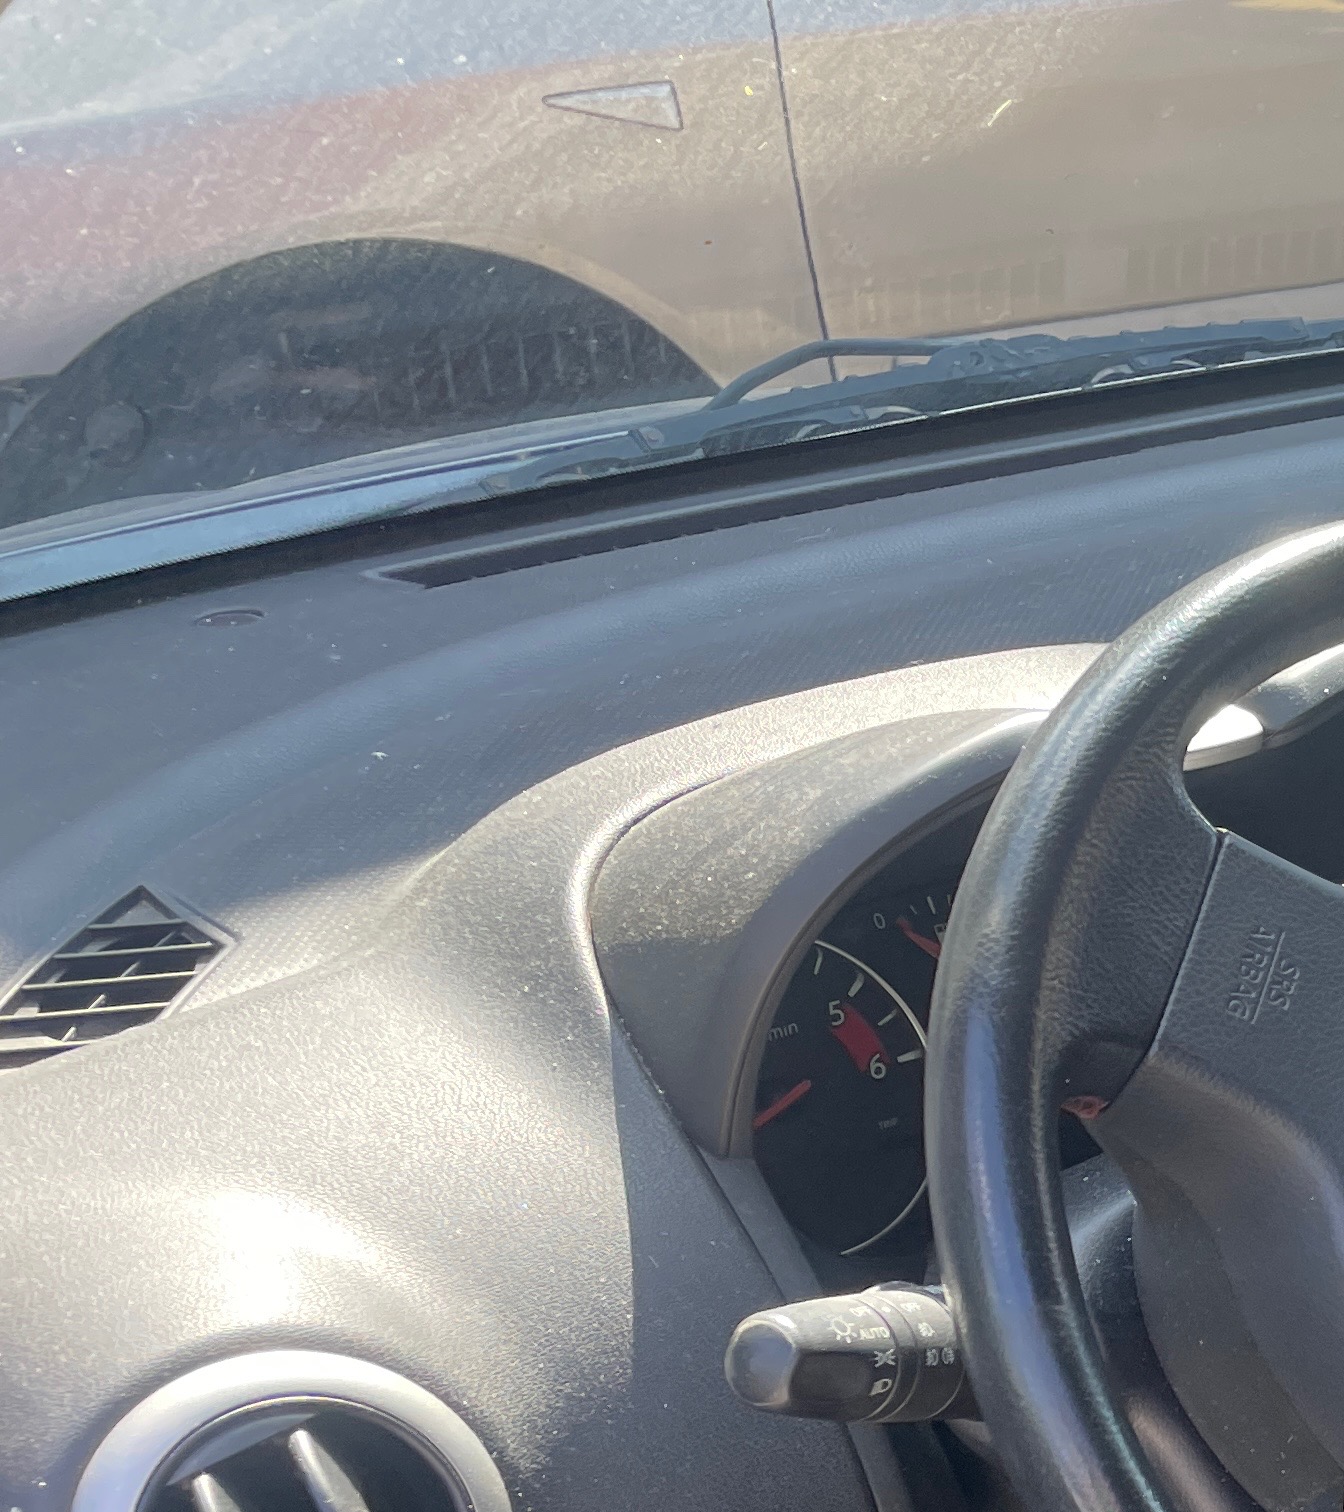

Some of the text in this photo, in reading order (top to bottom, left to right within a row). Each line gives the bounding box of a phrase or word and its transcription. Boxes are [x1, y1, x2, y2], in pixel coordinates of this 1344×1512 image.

[1226, 927, 1276, 1020] AIRBAG
[1268, 959, 1300, 1011] SRS
[828, 1000, 845, 1026] 5
[768, 1022, 799, 1042] min
[869, 1053, 887, 1079] 6
[860, 1326, 891, 1340] AUTO
